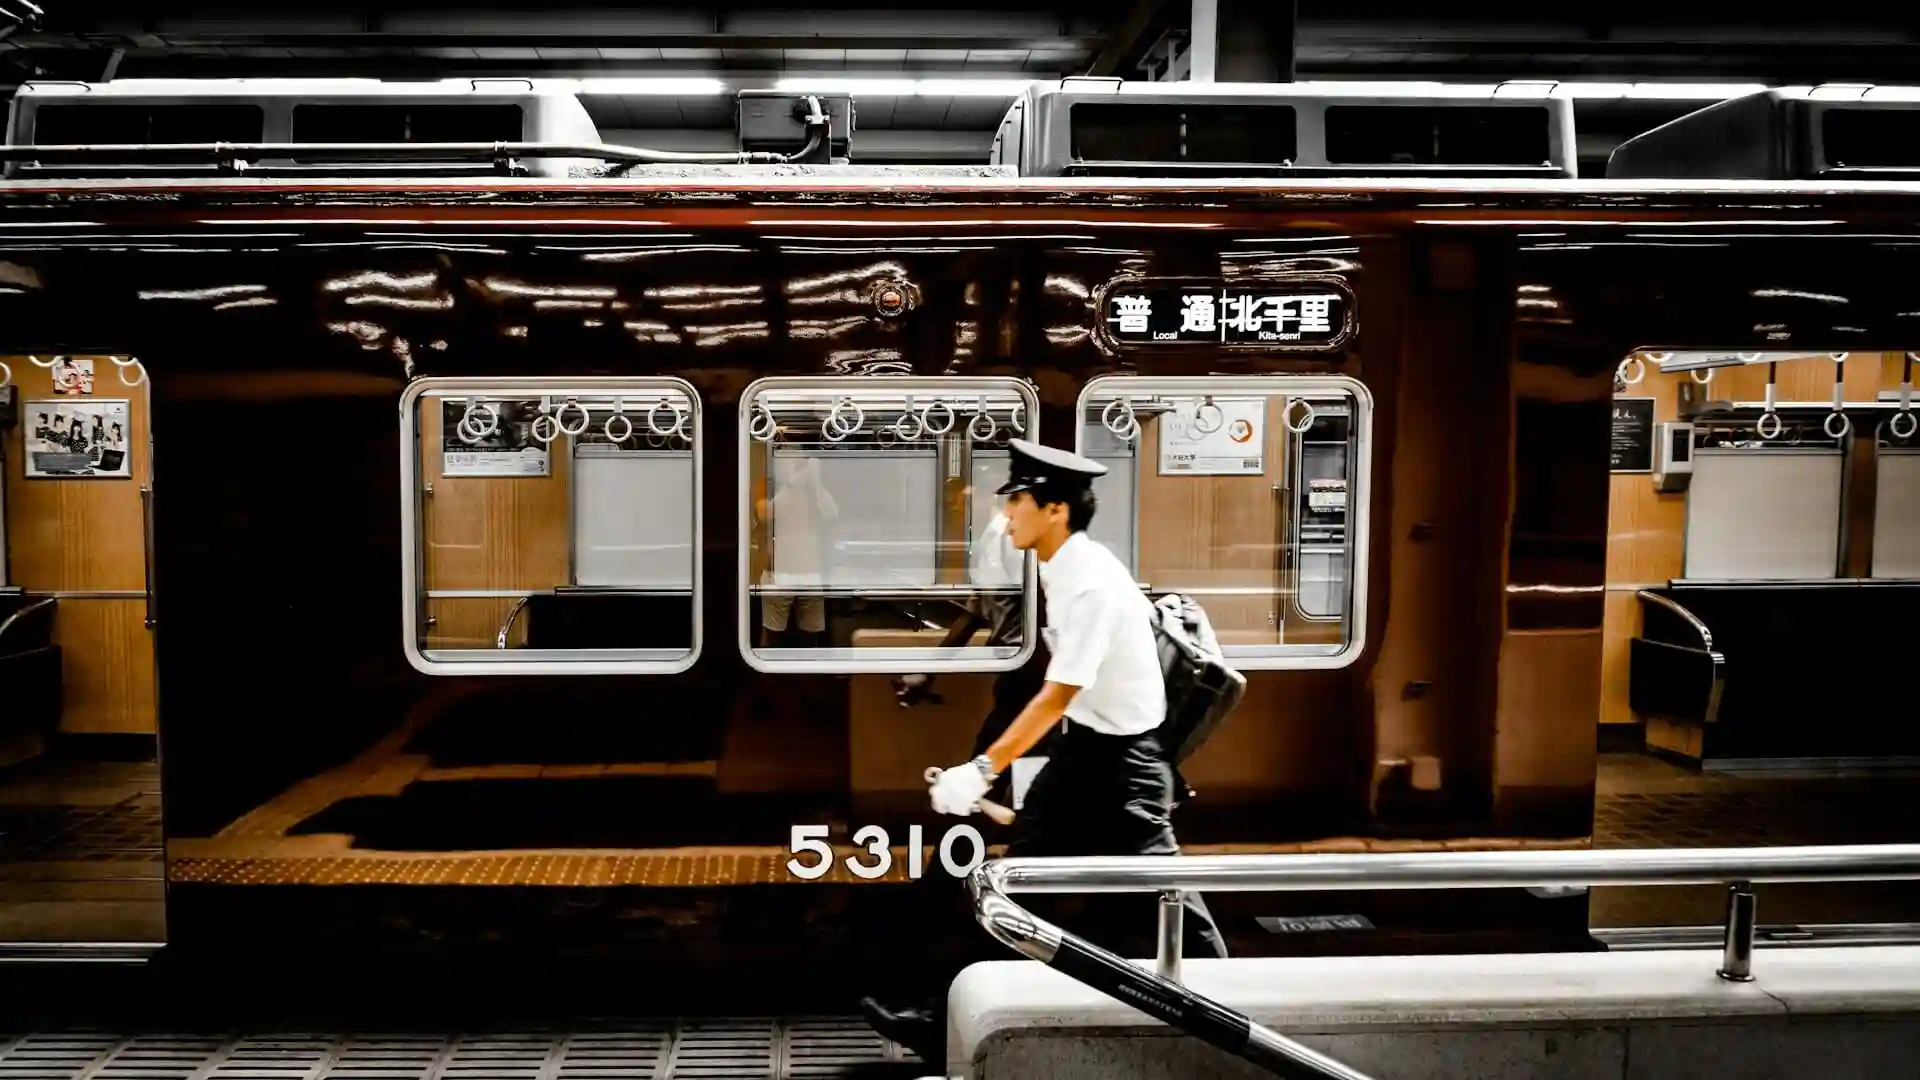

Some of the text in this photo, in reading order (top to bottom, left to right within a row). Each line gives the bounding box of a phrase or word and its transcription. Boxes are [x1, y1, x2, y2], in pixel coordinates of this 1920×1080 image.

[1116, 294, 1217, 333] 普通
[1229, 294, 1331, 333] 北千里
[1153, 331, 1178, 341] Local
[1258, 331, 1301, 341] Kita-senri
[786, 823, 986, 880] 5310
